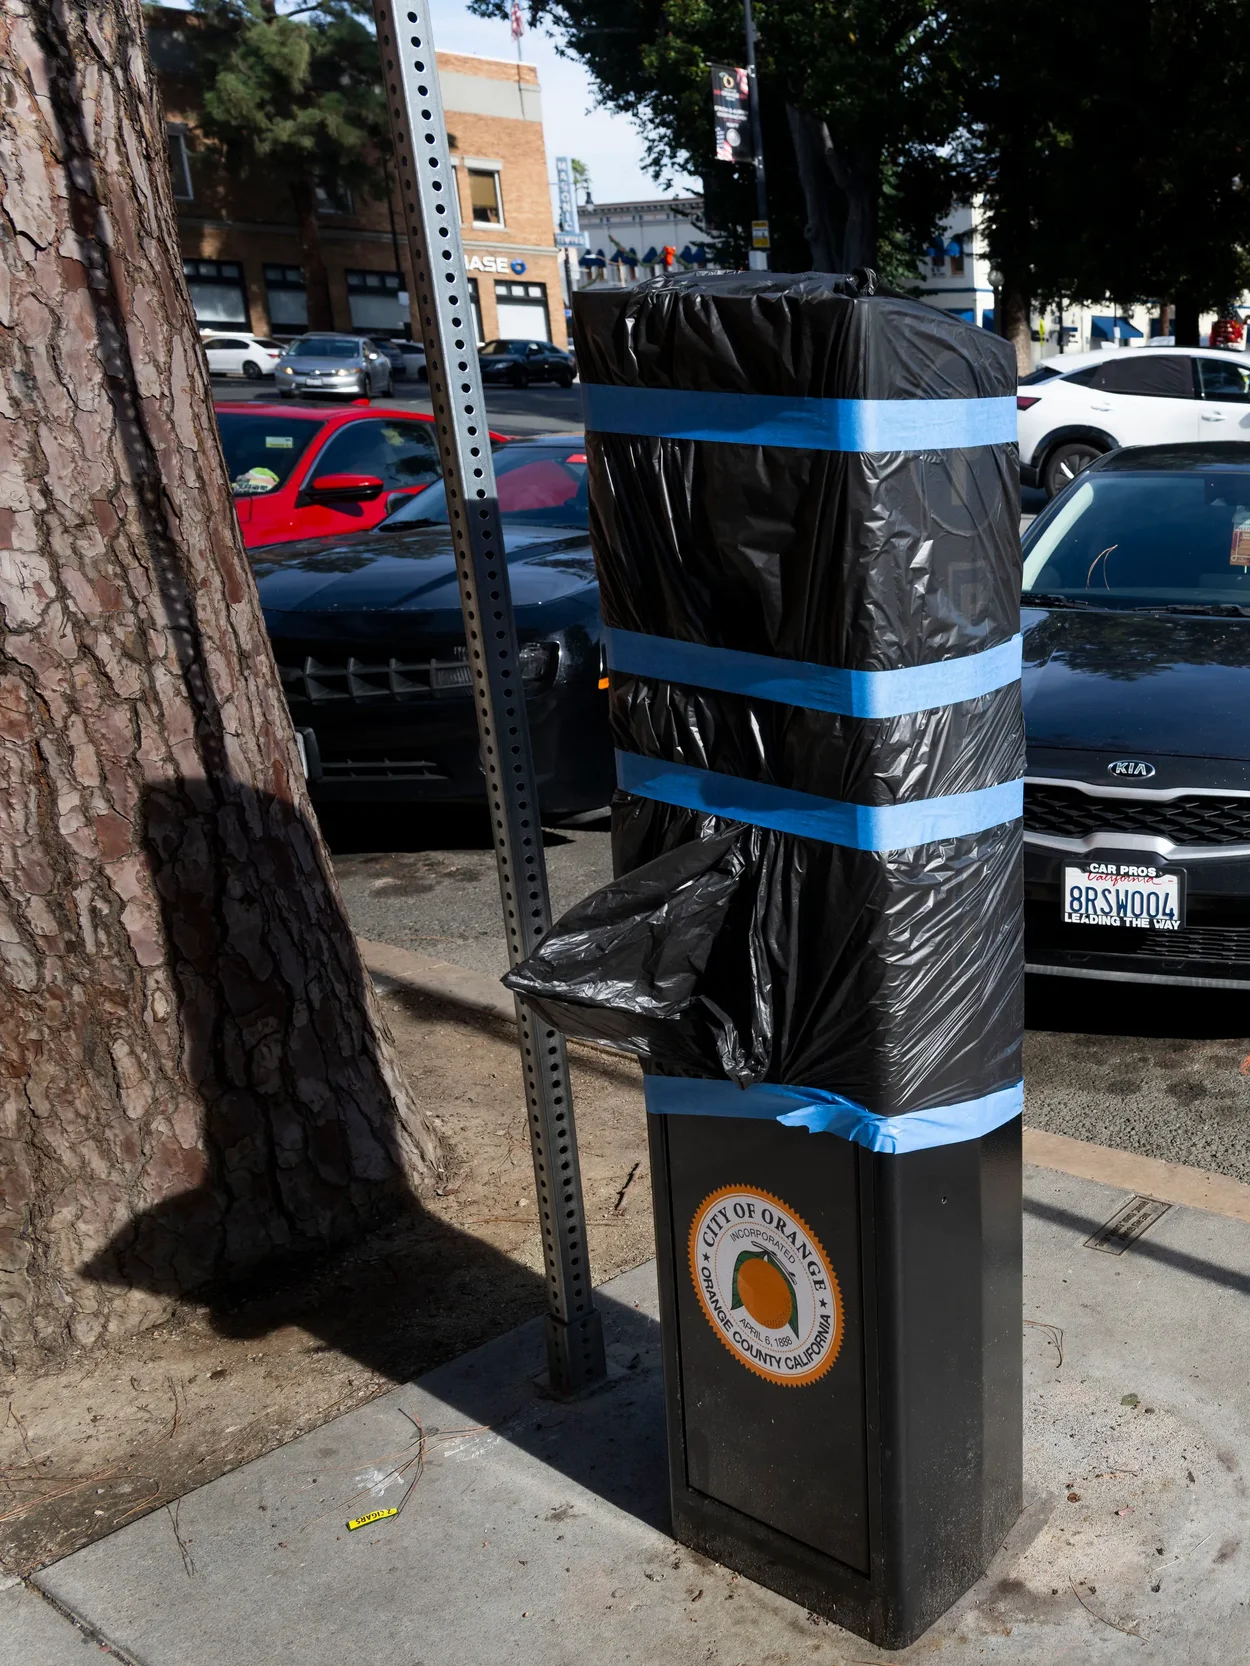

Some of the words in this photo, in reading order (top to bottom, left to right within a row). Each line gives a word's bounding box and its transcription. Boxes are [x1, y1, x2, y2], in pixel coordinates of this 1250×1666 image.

[464, 254, 510, 273] ASE
[1115, 762, 1147, 775] KIA
[1087, 872, 1162, 886] California
[1089, 863, 1118, 875] CAR
[1120, 865, 1157, 877] PROS
[1069, 886, 1175, 920] 8RSW004
[1065, 913, 1120, 926] LEADING
[1123, 917, 1150, 928] THE
[1153, 919, 1181, 930] WAY
[703, 1207, 734, 1248] CITY
[733, 1202, 755, 1219] OF
[761, 1209, 827, 1292] ORANGE
[730, 1228, 796, 1265] INCORPORATED
[701, 1266, 733, 1332] ORANGE
[732, 1331, 782, 1369] COUNTY
[784, 1314, 831, 1370] CALIFORNIA
[739, 1318, 764, 1343] APRIL
[764, 1336, 773, 1347] 6,
[774, 1336, 793, 1348] 1888
[355, 1510, 385, 1525] CIGARS
